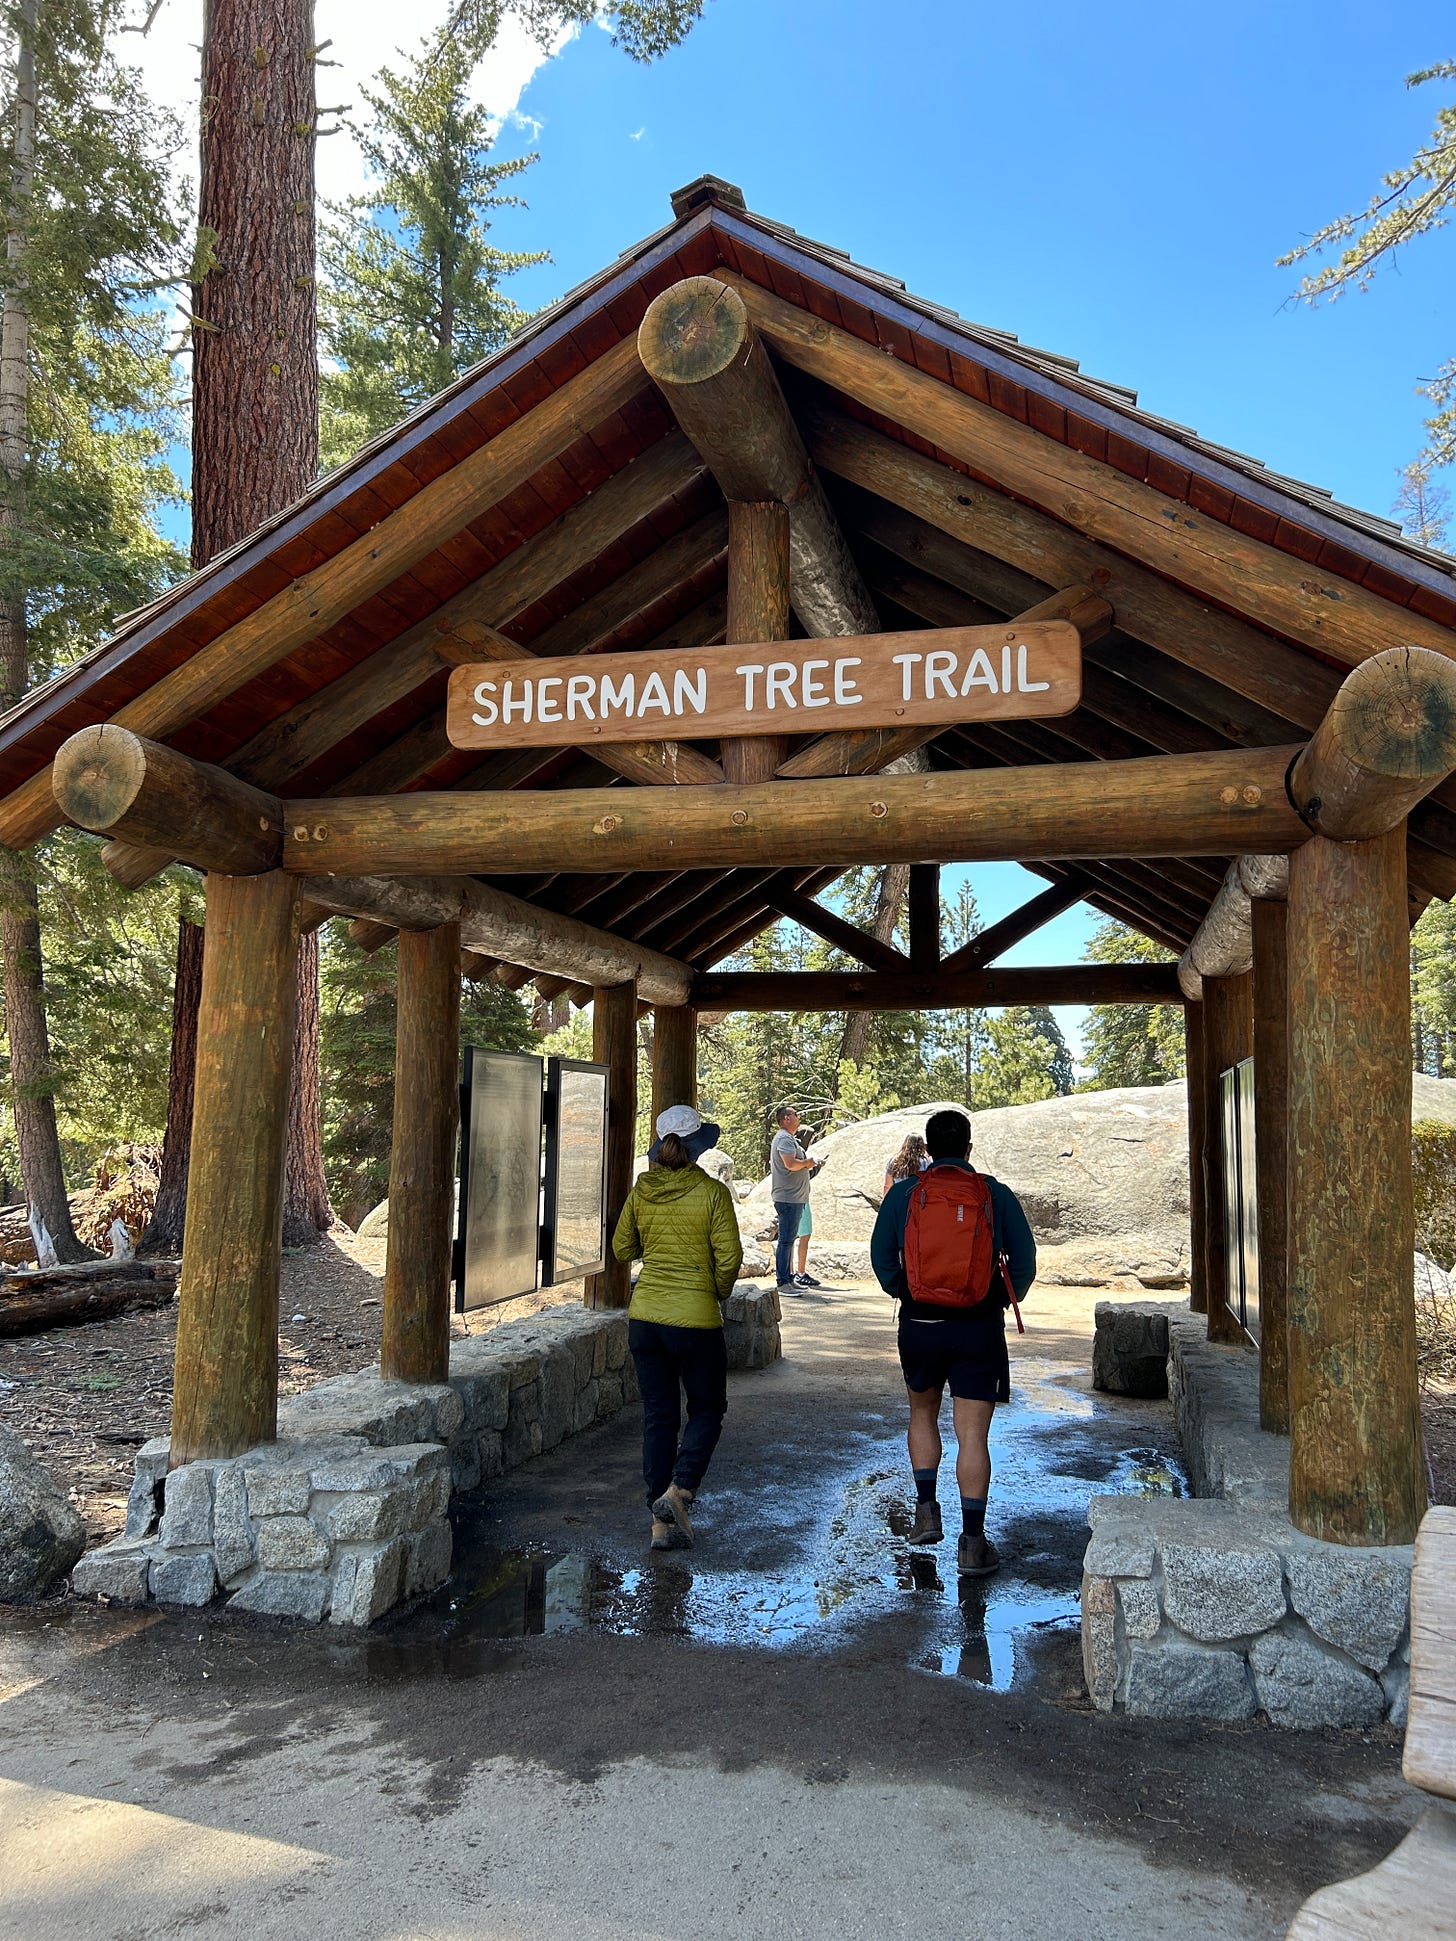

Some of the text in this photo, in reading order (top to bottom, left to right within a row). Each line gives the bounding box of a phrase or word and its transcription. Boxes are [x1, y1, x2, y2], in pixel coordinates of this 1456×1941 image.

[471, 644, 1050, 726] SHERMAN TREE TRAIL
